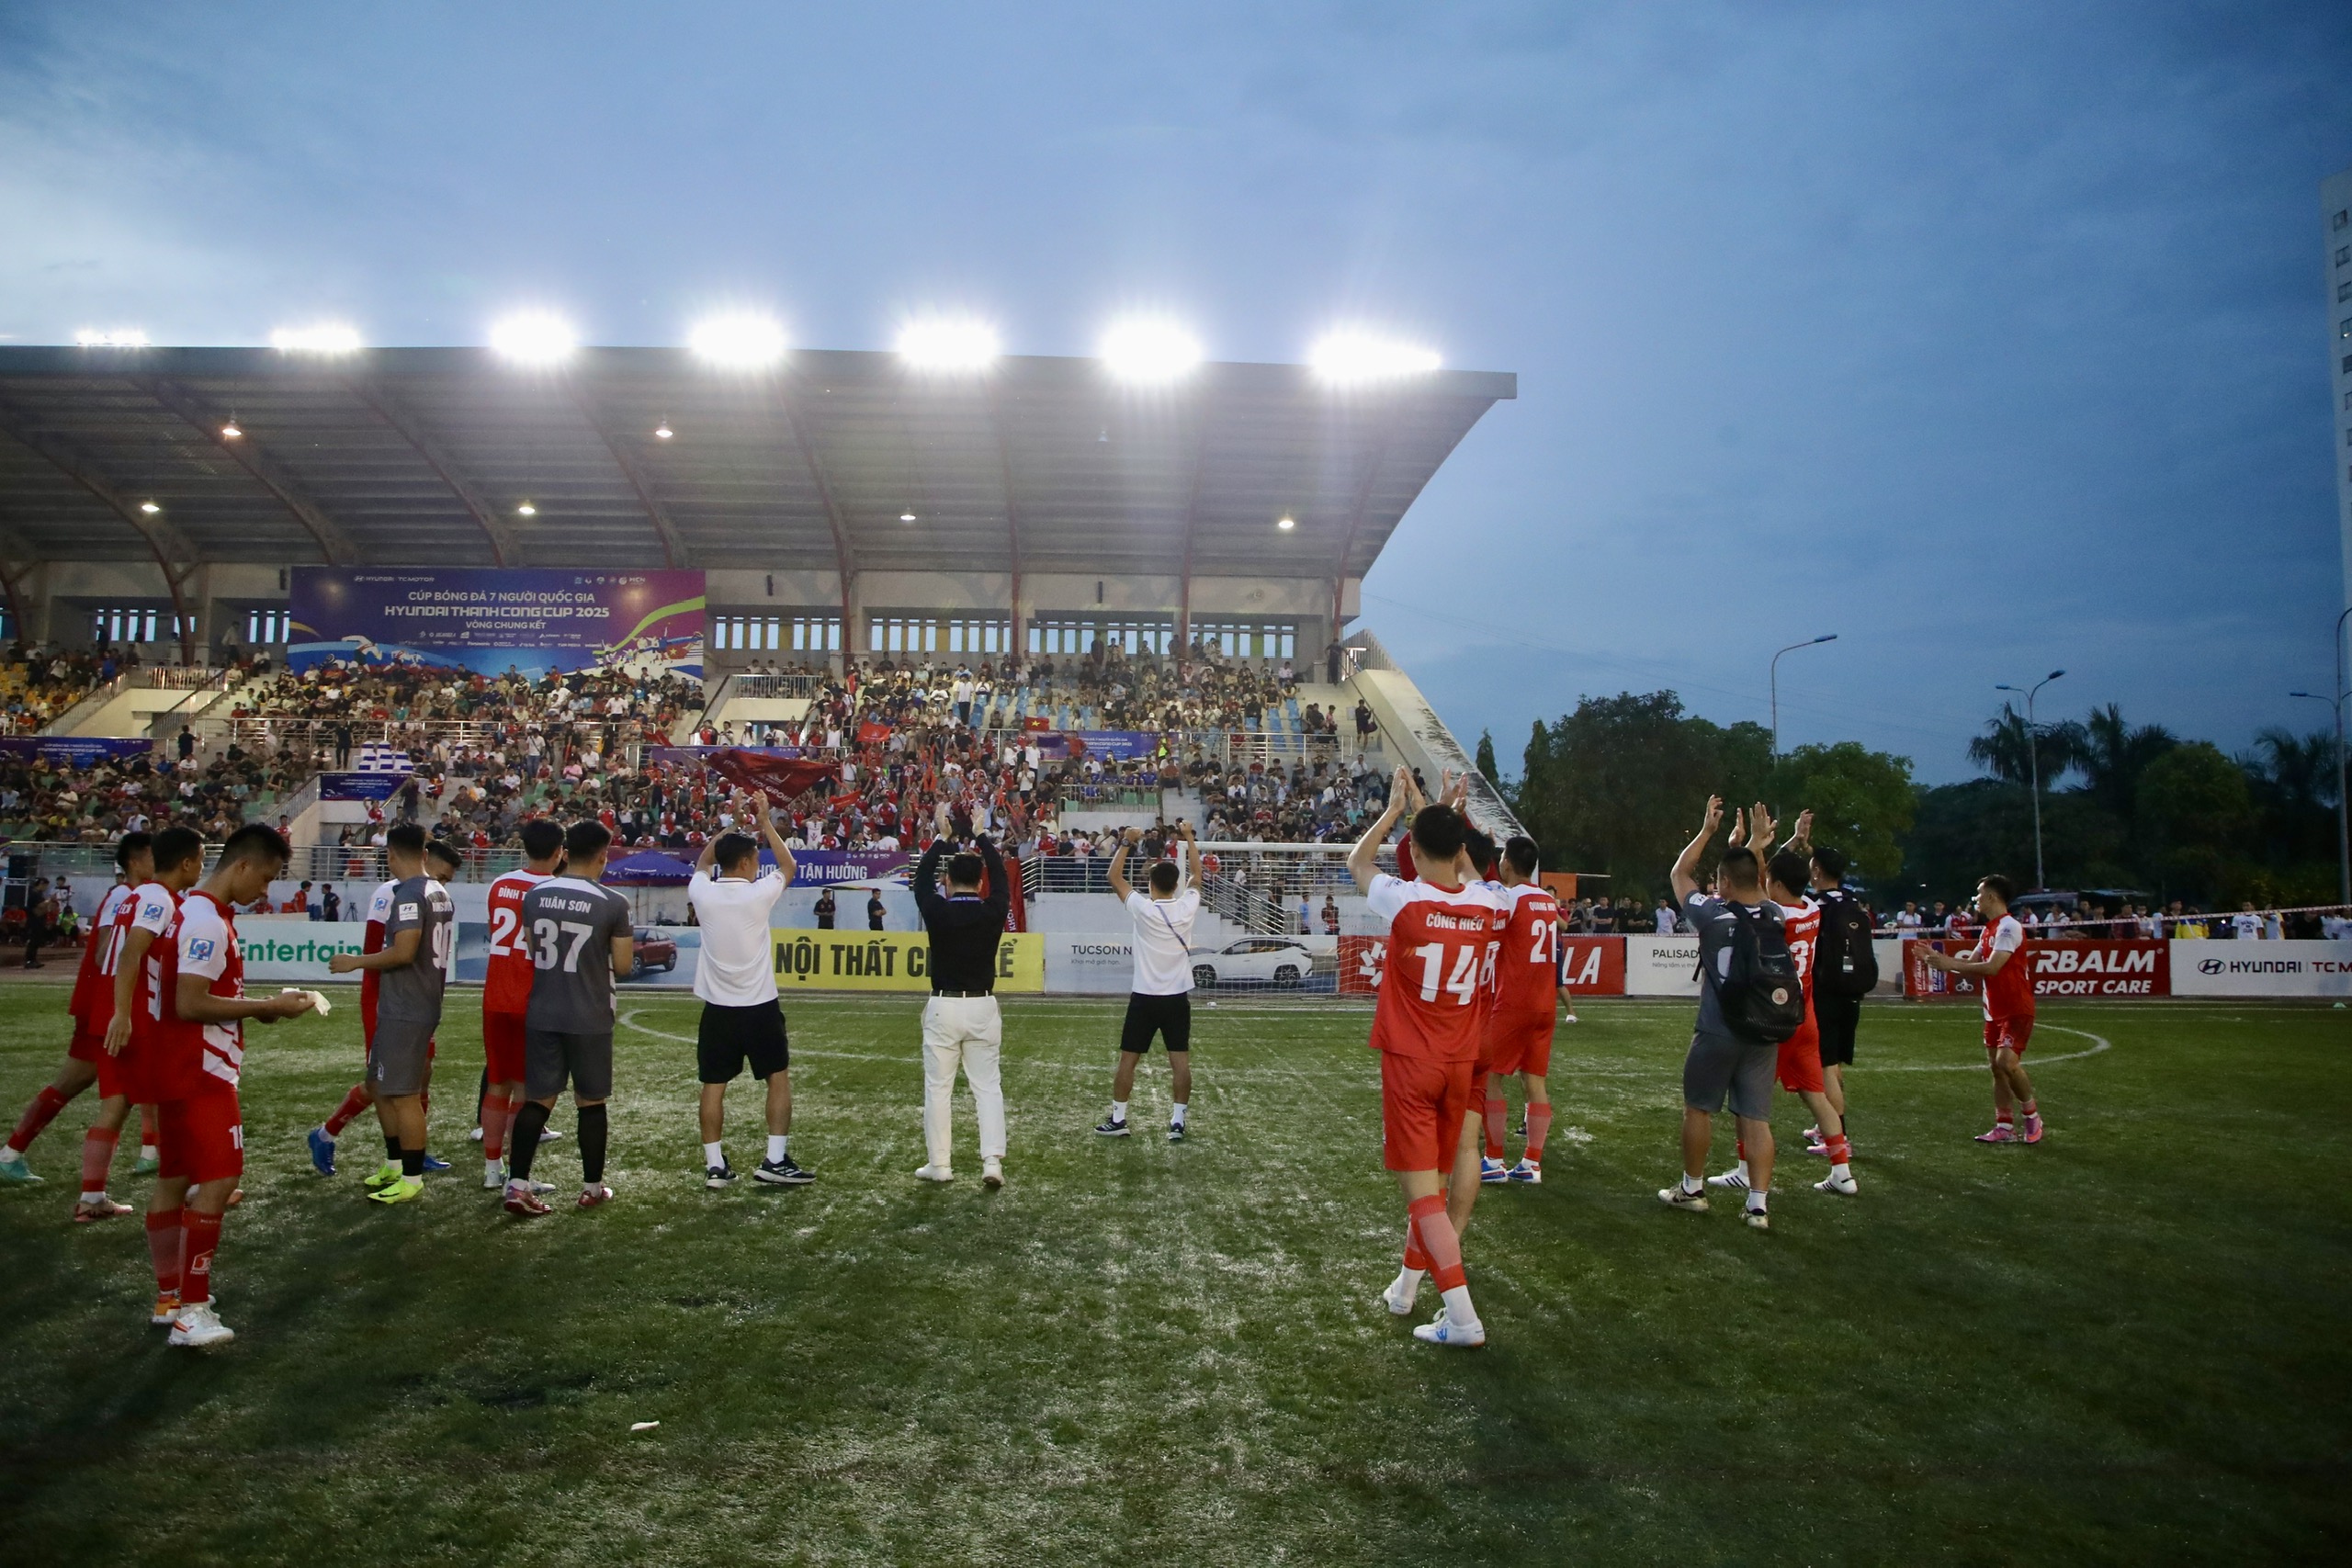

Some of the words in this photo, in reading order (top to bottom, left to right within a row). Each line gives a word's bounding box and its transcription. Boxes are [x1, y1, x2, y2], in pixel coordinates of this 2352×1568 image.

[408, 590, 432, 601] CÚP
[434, 590, 468, 602] BÓNG
[469, 590, 487, 602] ĐÁ
[489, 592, 496, 602] 7
[498, 591, 537, 603] NGƯỜI
[538, 590, 572, 604] QUỐC
[575, 592, 595, 603] GIA
[384, 606, 448, 616] HYUNDAI
[451, 606, 499, 617] THANH
[501, 606, 540, 617] CONG
[542, 607, 573, 617] CUP
[575, 607, 610, 618] 2025
[466, 619, 492, 629] VÒNG
[494, 621, 527, 629] CHUNG
[529, 619, 547, 629] KẾT
[798, 863, 822, 882] TẬN
[826, 861, 868, 880] HƯỞNG
[538, 896, 567, 910] XUÂN
[568, 899, 593, 914] SƠN
[1425, 912, 1457, 930] CÔNG
[1458, 915, 1485, 931] HIẾU
[490, 907, 533, 961] 24
[1529, 919, 1557, 964] 21
[533, 918, 594, 973] 37
[1071, 945, 1121, 955] TUCSON
[775, 936, 820, 981] NỘI
[831, 938, 898, 977] THẤT
[2230, 961, 2301, 974] HYUNDAI
[2312, 962, 2335, 973] TC
[1415, 942, 1478, 1006] 14
[2034, 980, 2095, 995] SPORT
[2096, 979, 2153, 994] CARE
